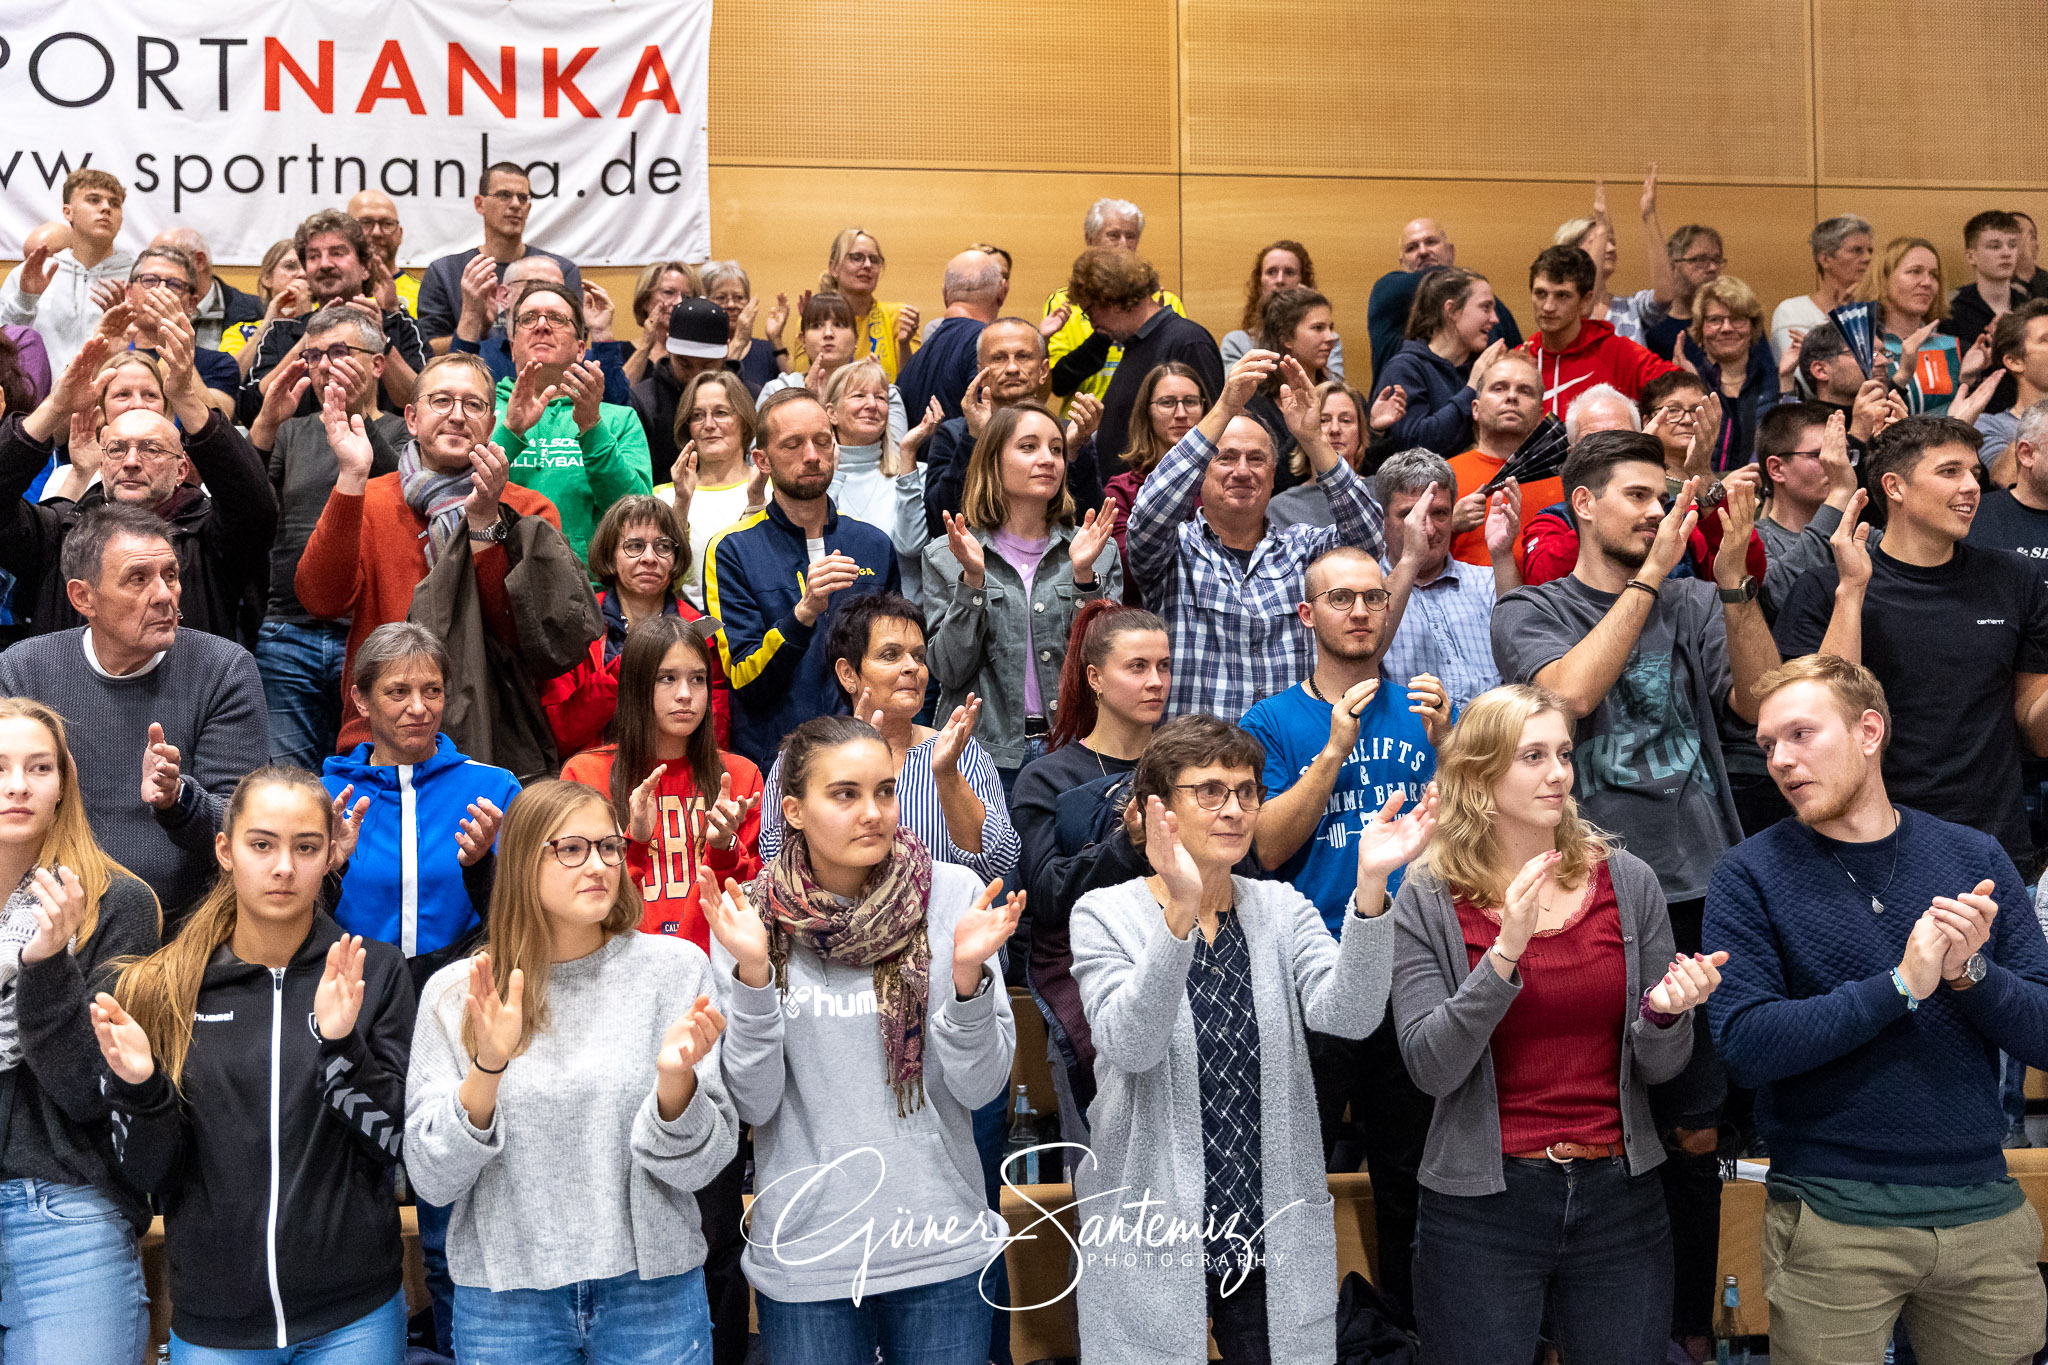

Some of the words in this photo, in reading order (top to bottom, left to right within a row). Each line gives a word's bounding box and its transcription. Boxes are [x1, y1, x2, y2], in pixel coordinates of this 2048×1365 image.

[0, 31, 682, 119] ORTNANKA
[510, 456, 584, 468] LLEYBAL
[857, 567, 876, 576] GA
[1359, 764, 1370, 785] &
[1322, 789, 1365, 815] MMY
[193, 1010, 234, 1022] hummel
